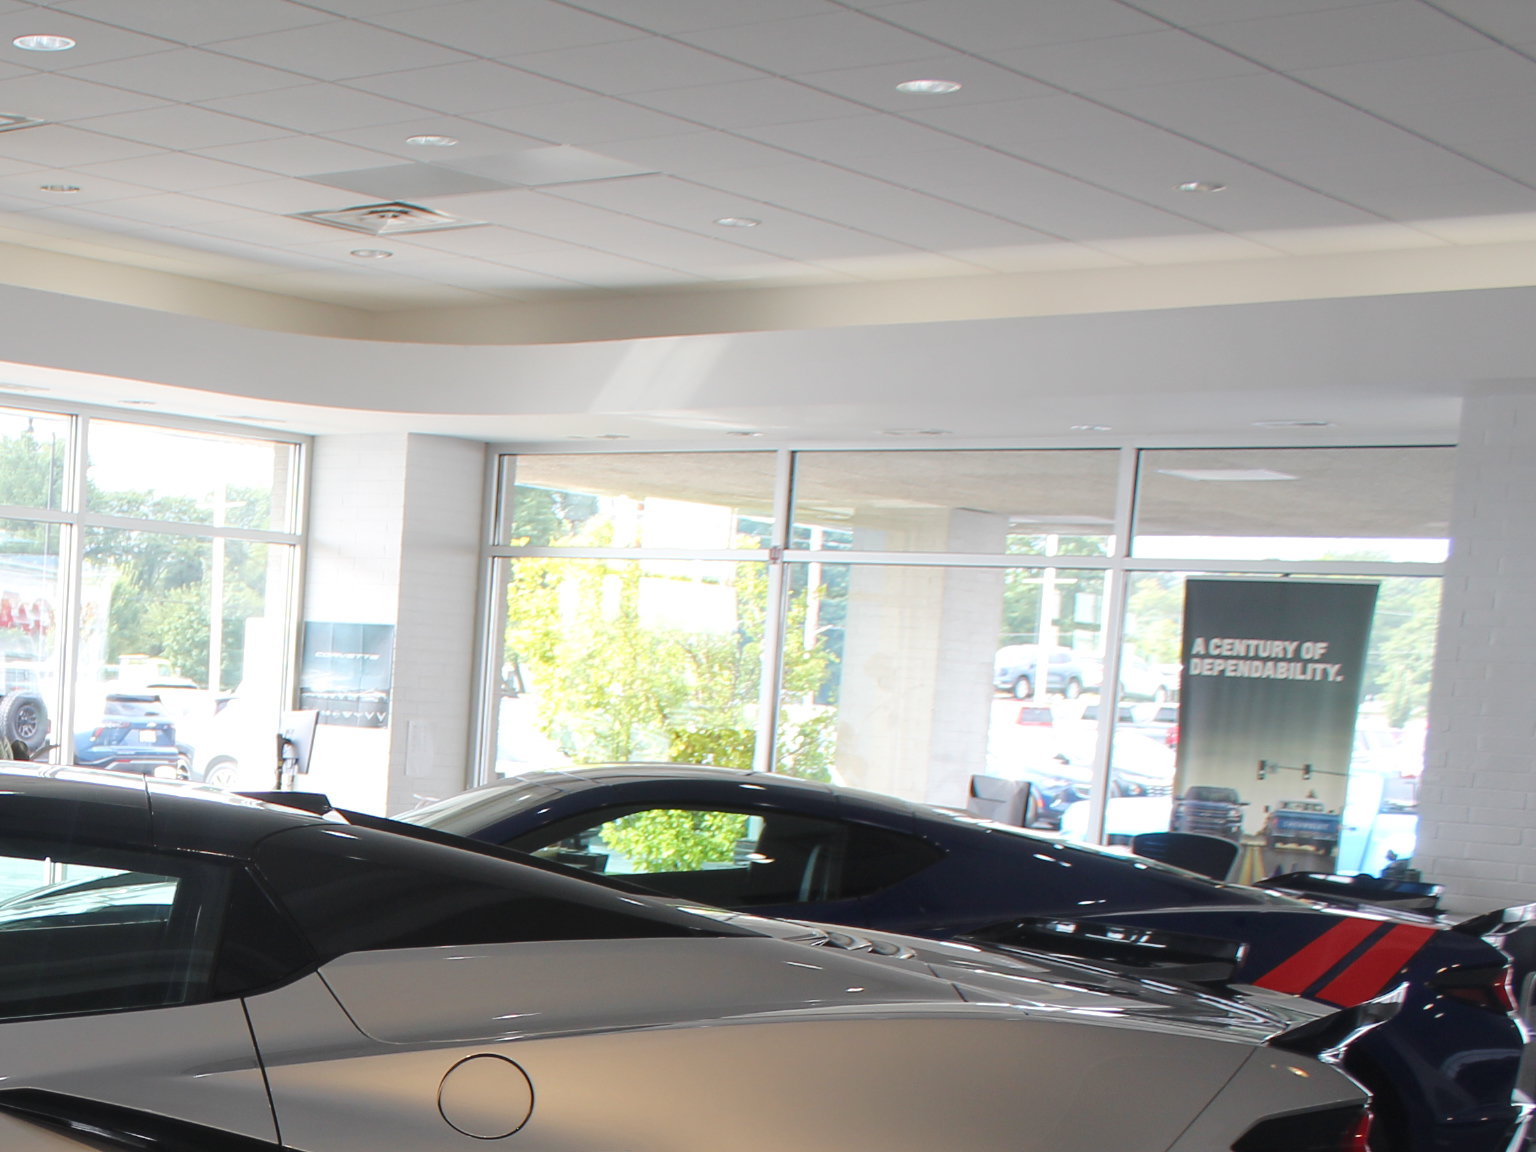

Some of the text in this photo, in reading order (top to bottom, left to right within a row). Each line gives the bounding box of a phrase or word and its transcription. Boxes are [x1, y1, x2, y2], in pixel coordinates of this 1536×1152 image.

[1191, 637, 1329, 660] A CENTURY OF
[1189, 657, 1345, 682] DEPENDABILITY.
